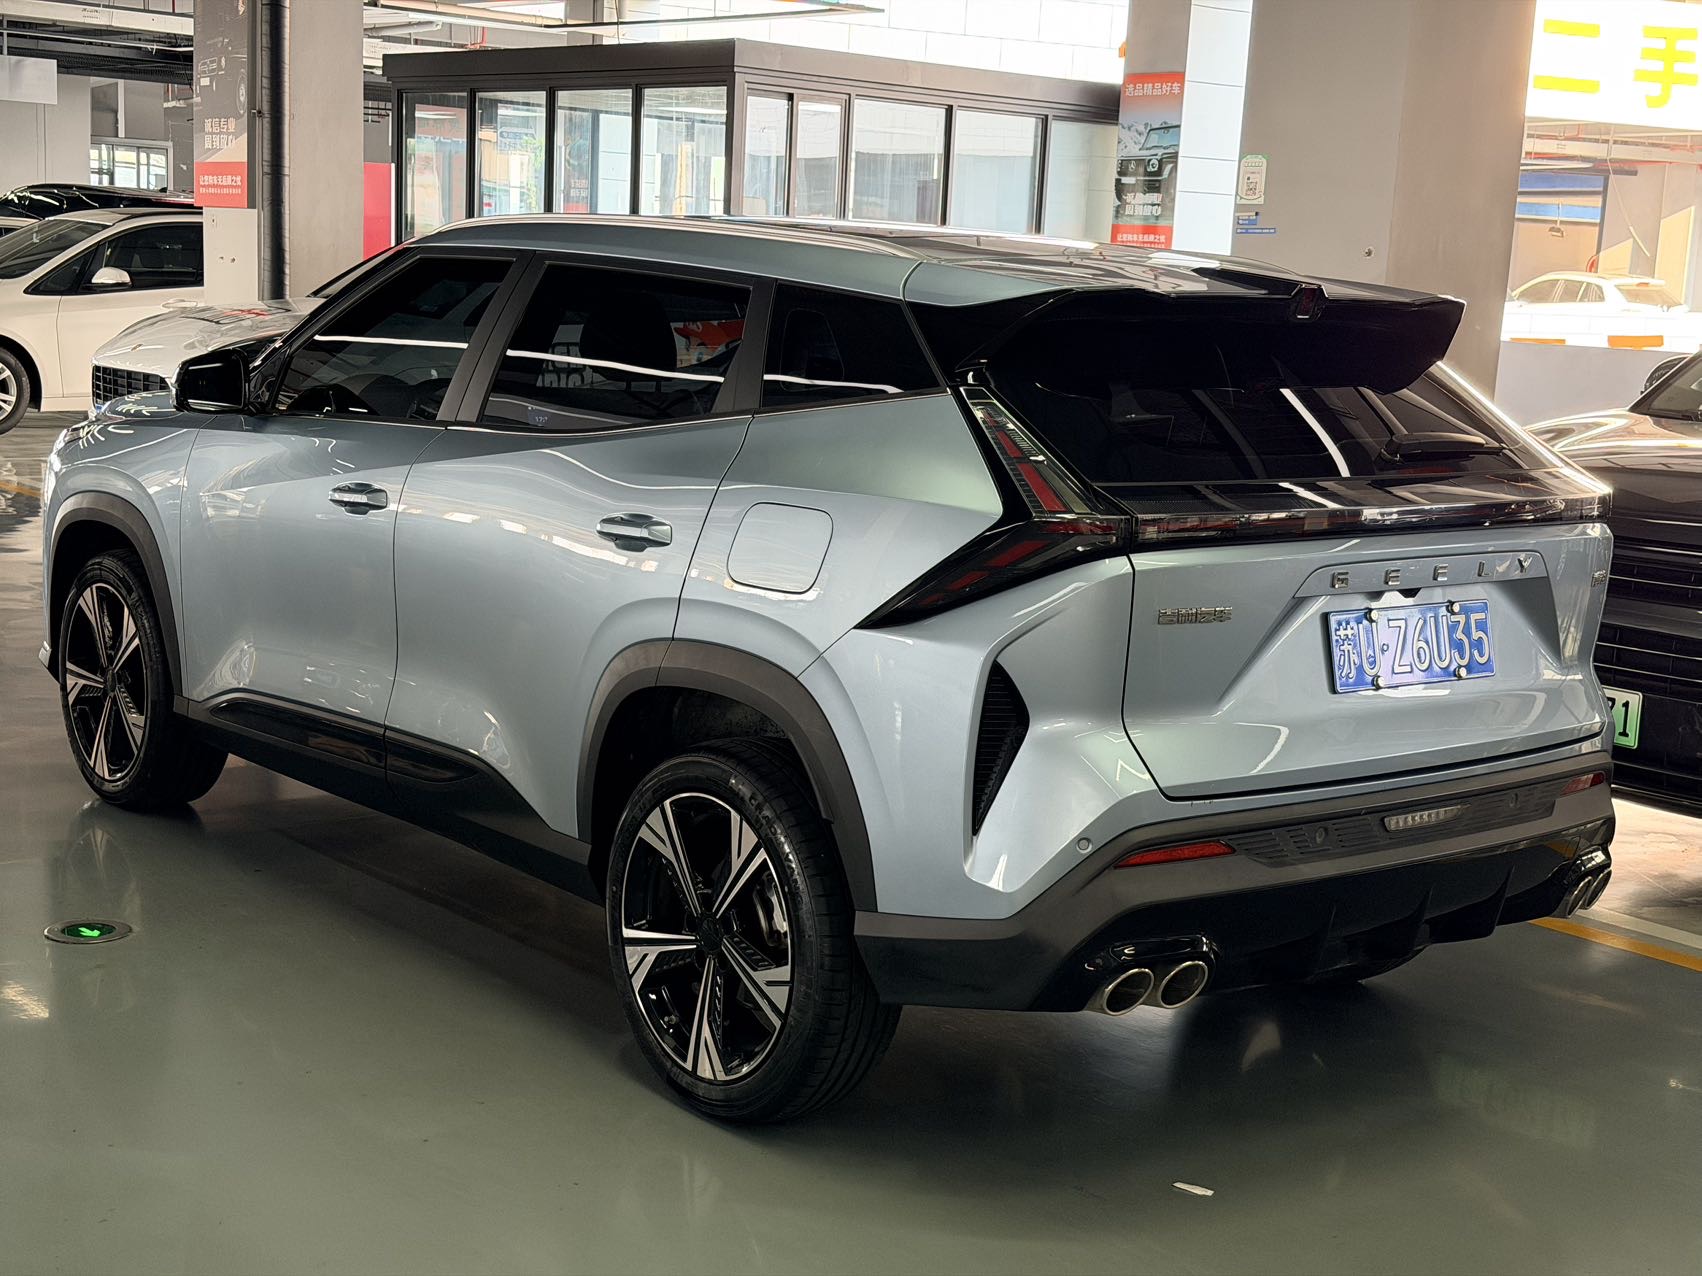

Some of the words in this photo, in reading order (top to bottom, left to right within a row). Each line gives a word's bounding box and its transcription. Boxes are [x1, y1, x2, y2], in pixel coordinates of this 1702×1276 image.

[1533, 19, 1698, 108] 二手
[204, 117, 236, 133] 诚信专业
[1332, 556, 1532, 589] GEELY
[1158, 606, 1232, 625] 吉利汽车
